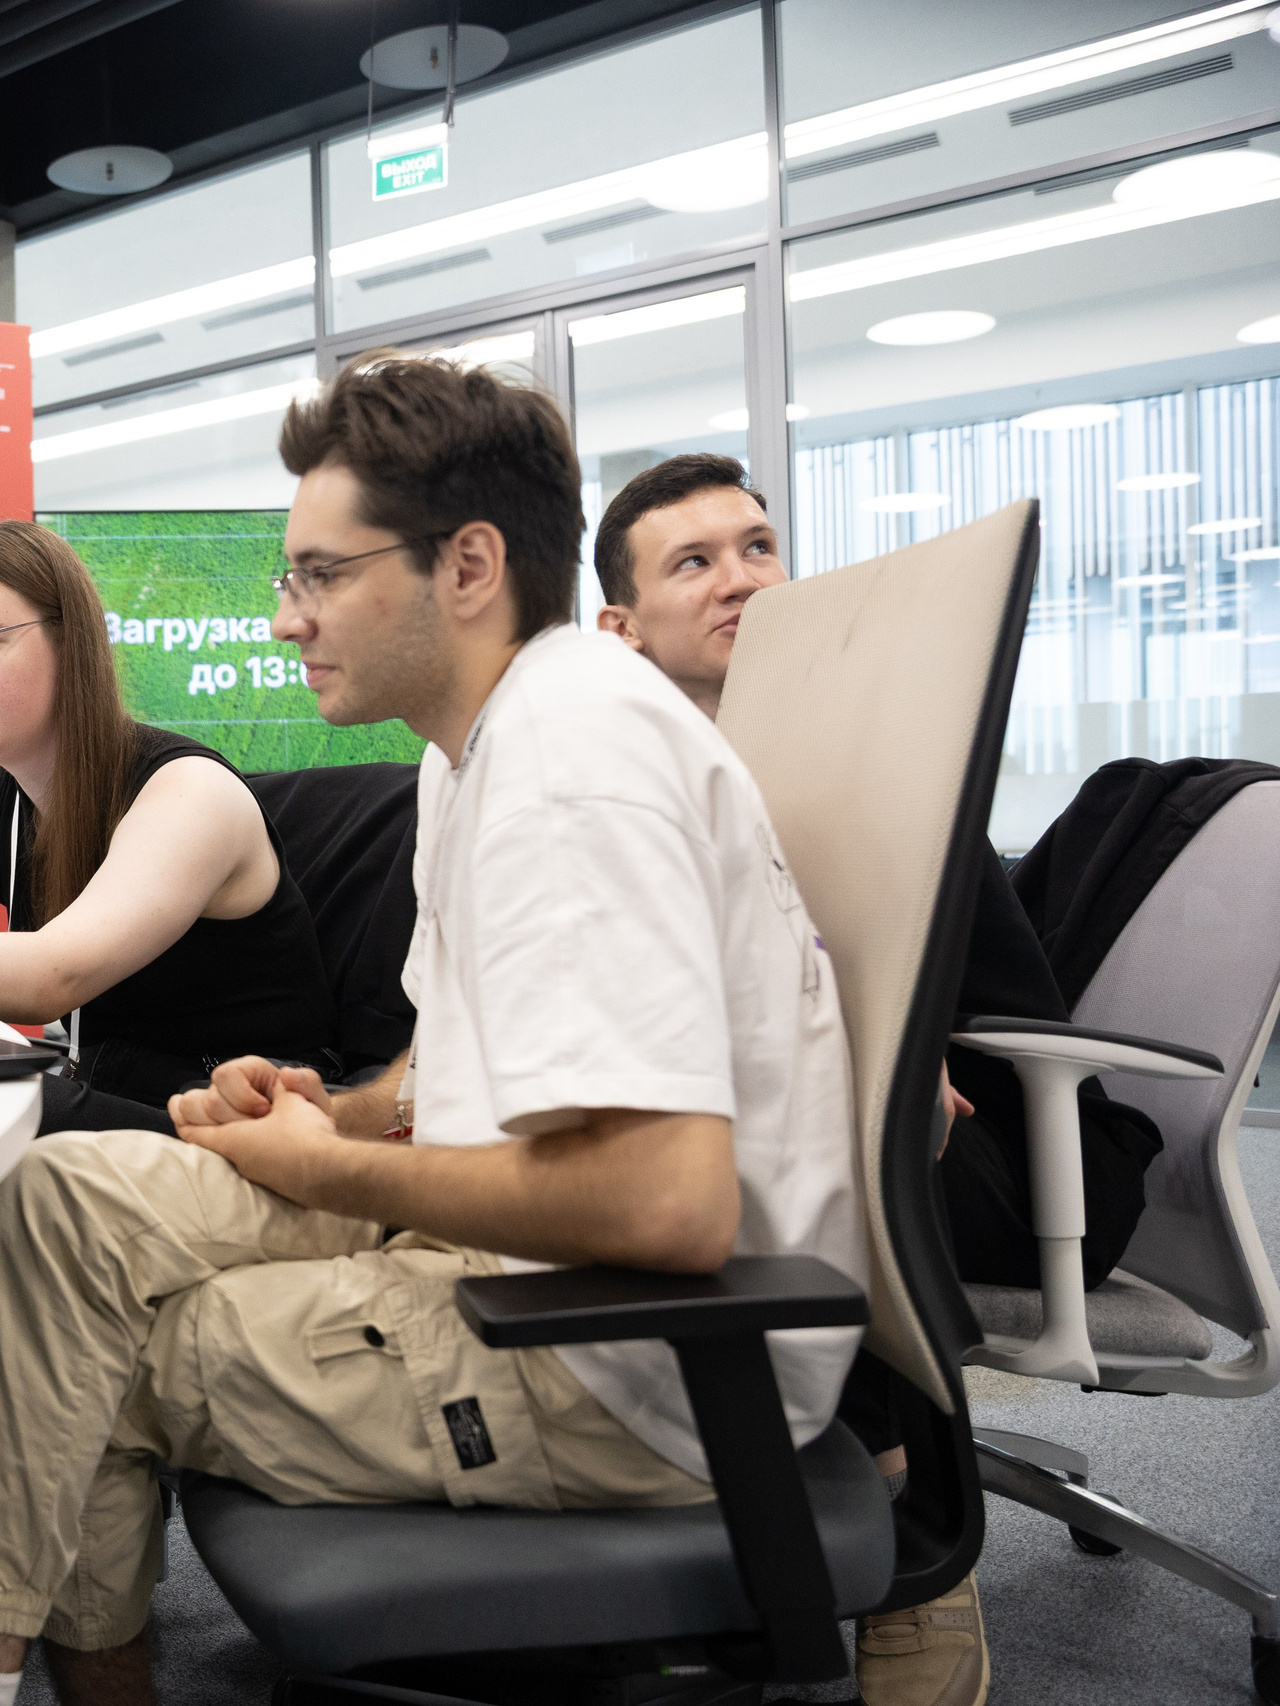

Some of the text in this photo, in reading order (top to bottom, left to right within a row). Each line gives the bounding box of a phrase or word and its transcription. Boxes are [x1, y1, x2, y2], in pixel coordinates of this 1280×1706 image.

[381, 153, 437, 178] ВЫХОД
[392, 171, 425, 189] EXIT
[104, 611, 272, 651] Загрузка
[188, 663, 237, 695] до
